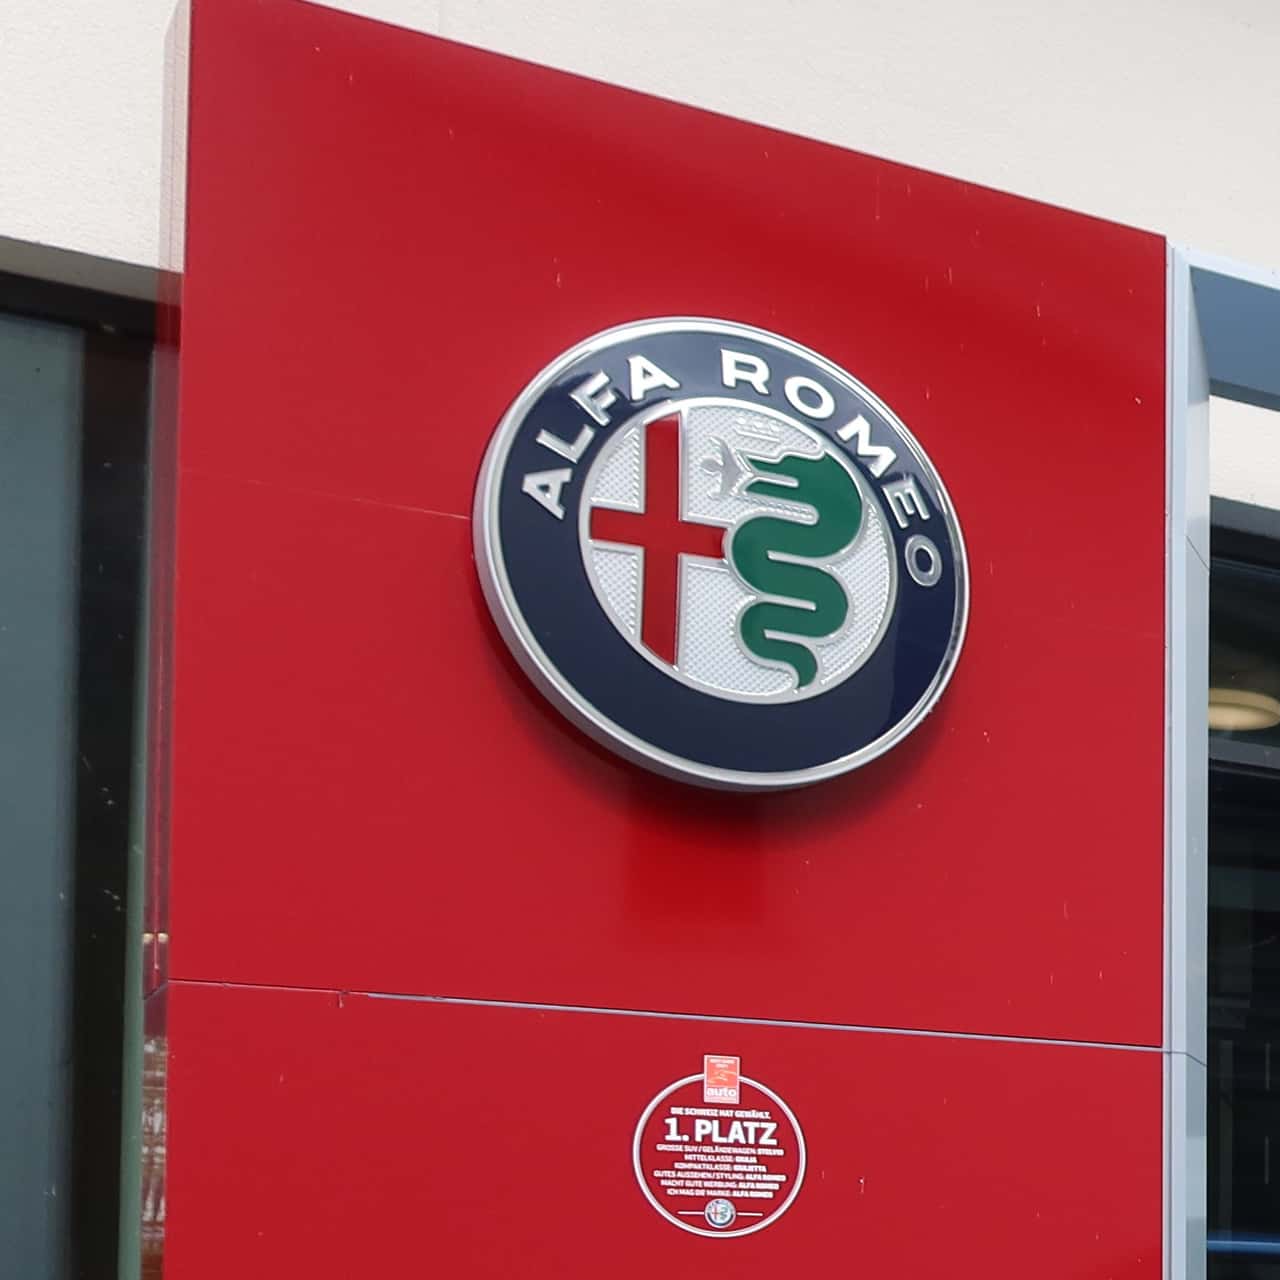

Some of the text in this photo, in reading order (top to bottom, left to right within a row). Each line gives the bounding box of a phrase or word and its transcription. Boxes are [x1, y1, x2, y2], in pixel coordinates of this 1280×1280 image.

[521, 347, 942, 587] ALFA ROMEO
[706, 1087, 737, 1097] auto
[665, 1117, 777, 1145] 1. PLATZ
